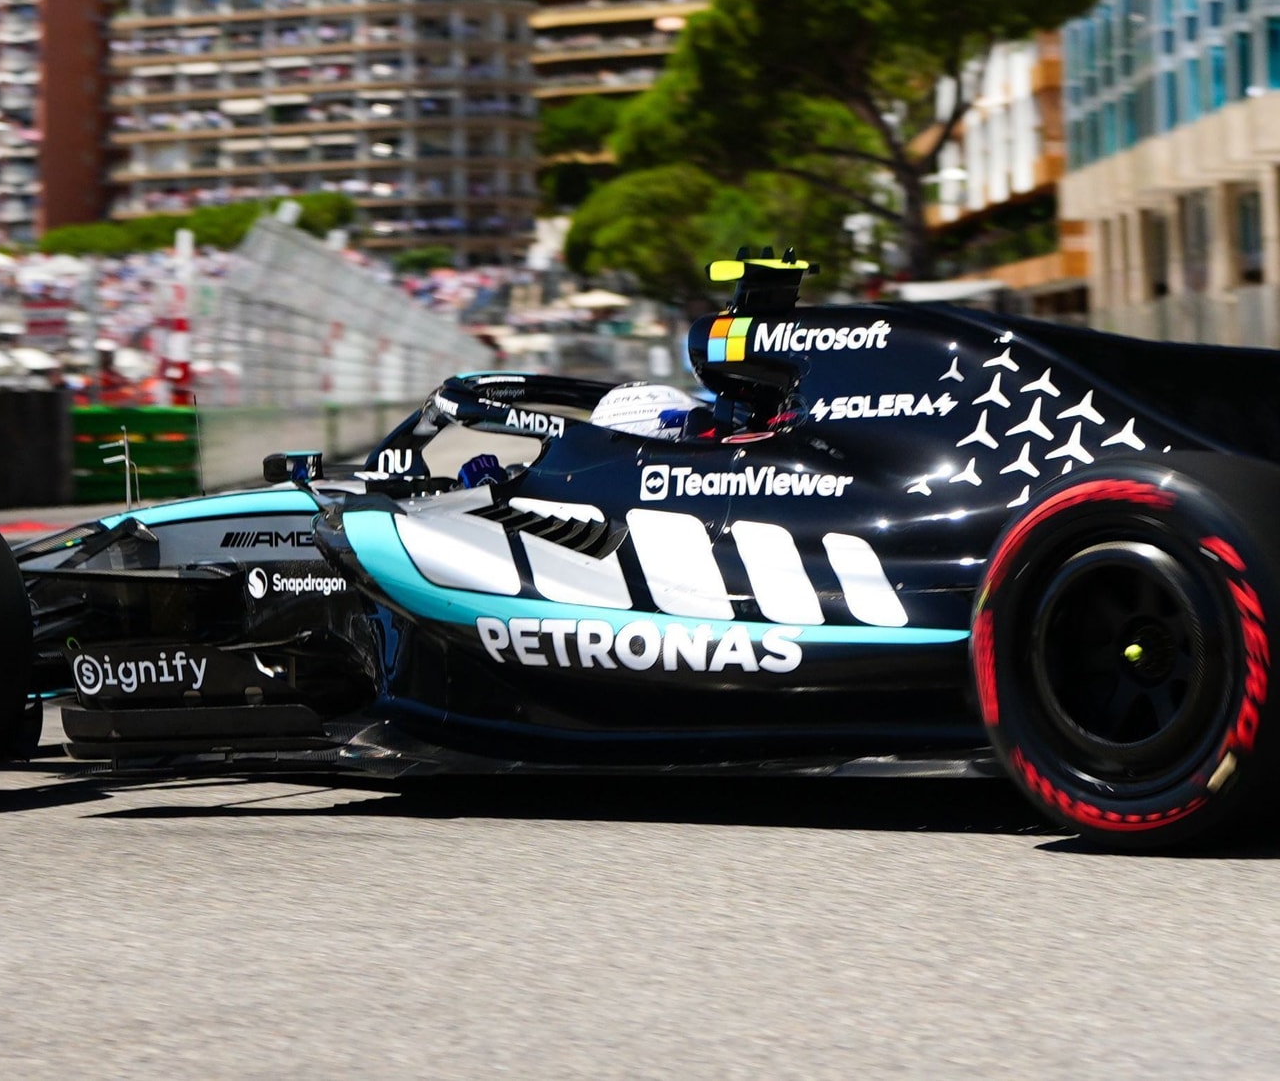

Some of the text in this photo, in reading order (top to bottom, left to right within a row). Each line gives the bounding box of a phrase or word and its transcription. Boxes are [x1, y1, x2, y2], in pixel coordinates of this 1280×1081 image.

[753, 319, 892, 353] Microsoft
[505, 409, 549, 433] AMD
[829, 393, 935, 420] SOLERA
[670, 465, 854, 498] TeamViewer
[271, 573, 347, 596] Snapdragon
[475, 616, 804, 674] PETRONAS
